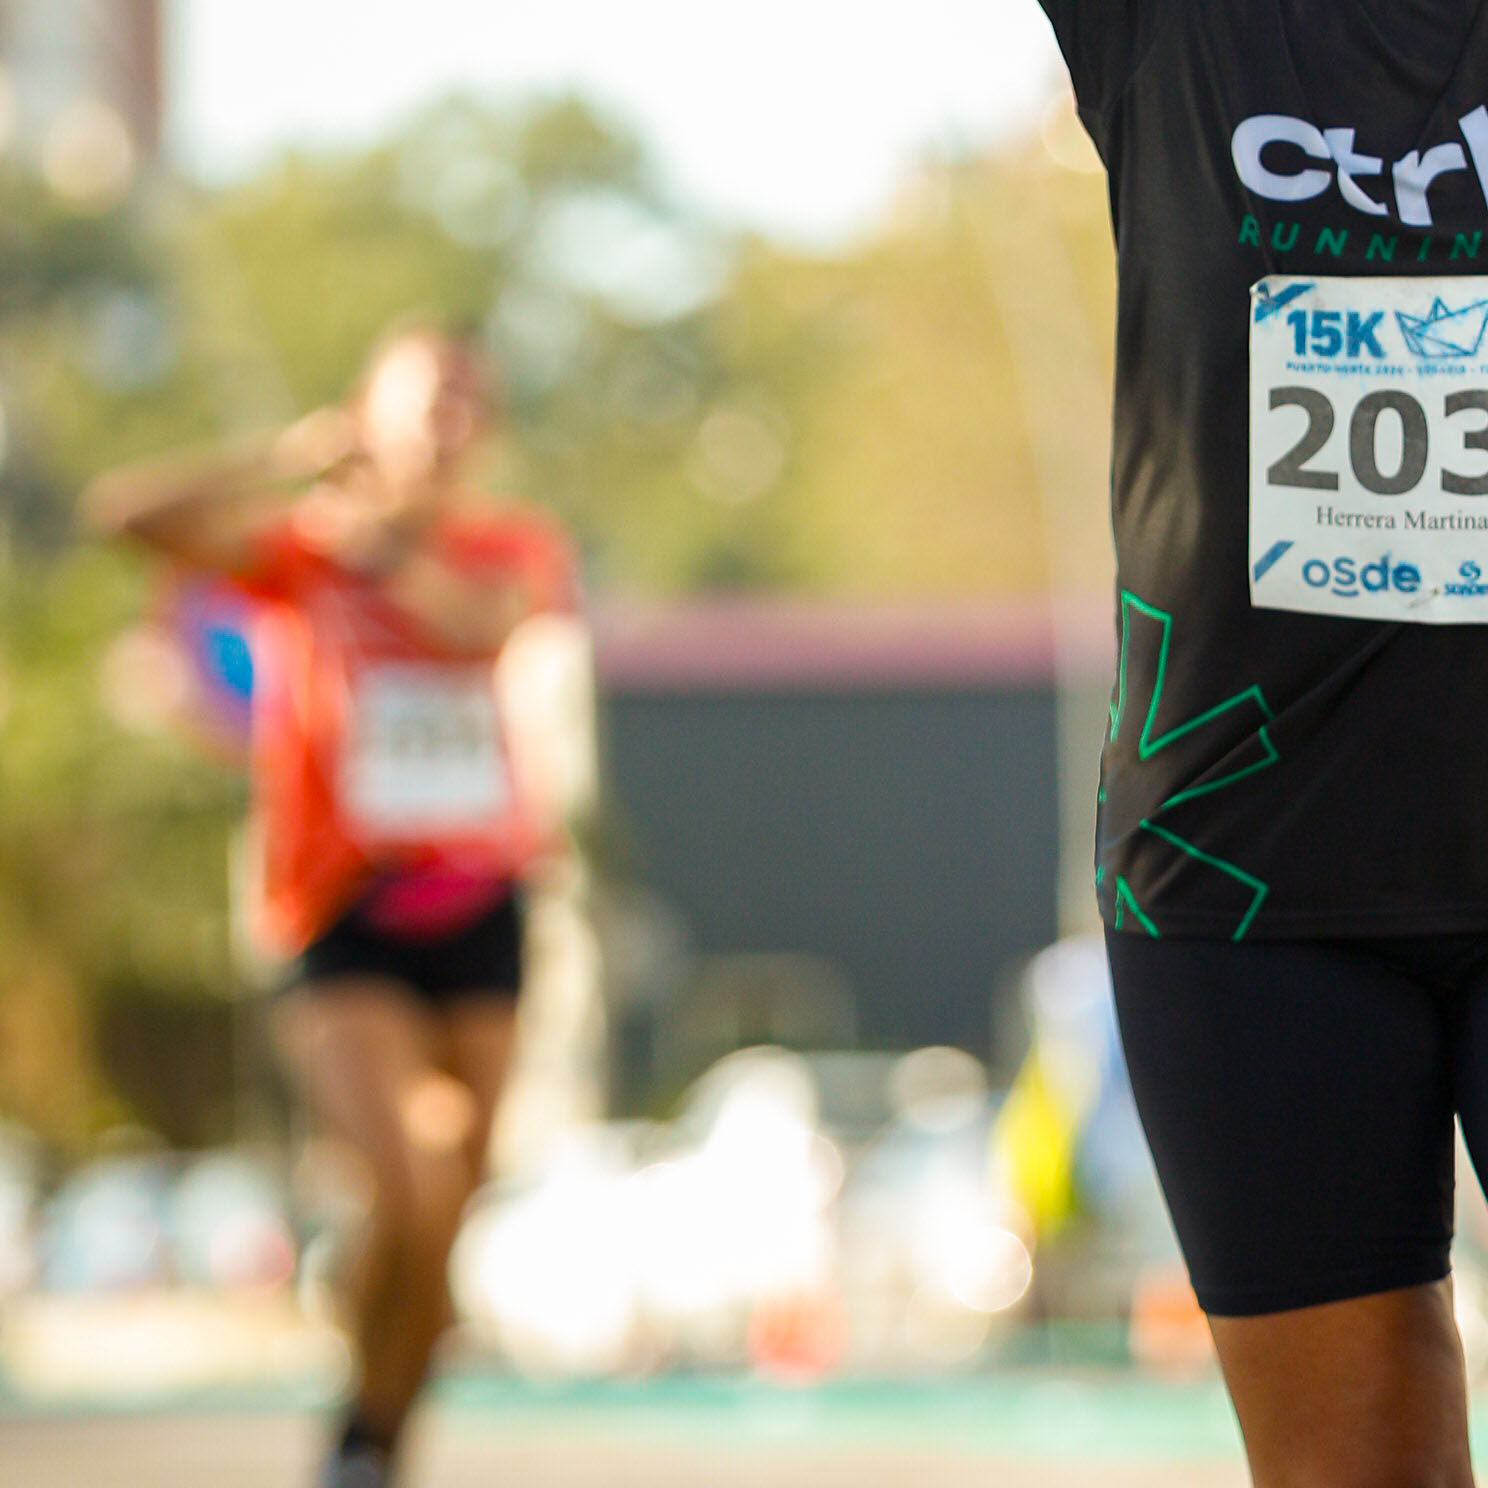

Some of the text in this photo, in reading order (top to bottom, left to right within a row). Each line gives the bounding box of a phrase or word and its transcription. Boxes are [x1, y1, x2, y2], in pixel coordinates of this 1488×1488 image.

[1286, 308, 1387, 359] 15K
[1315, 506, 1397, 530] Herrera
[1302, 550, 1421, 597] osde
